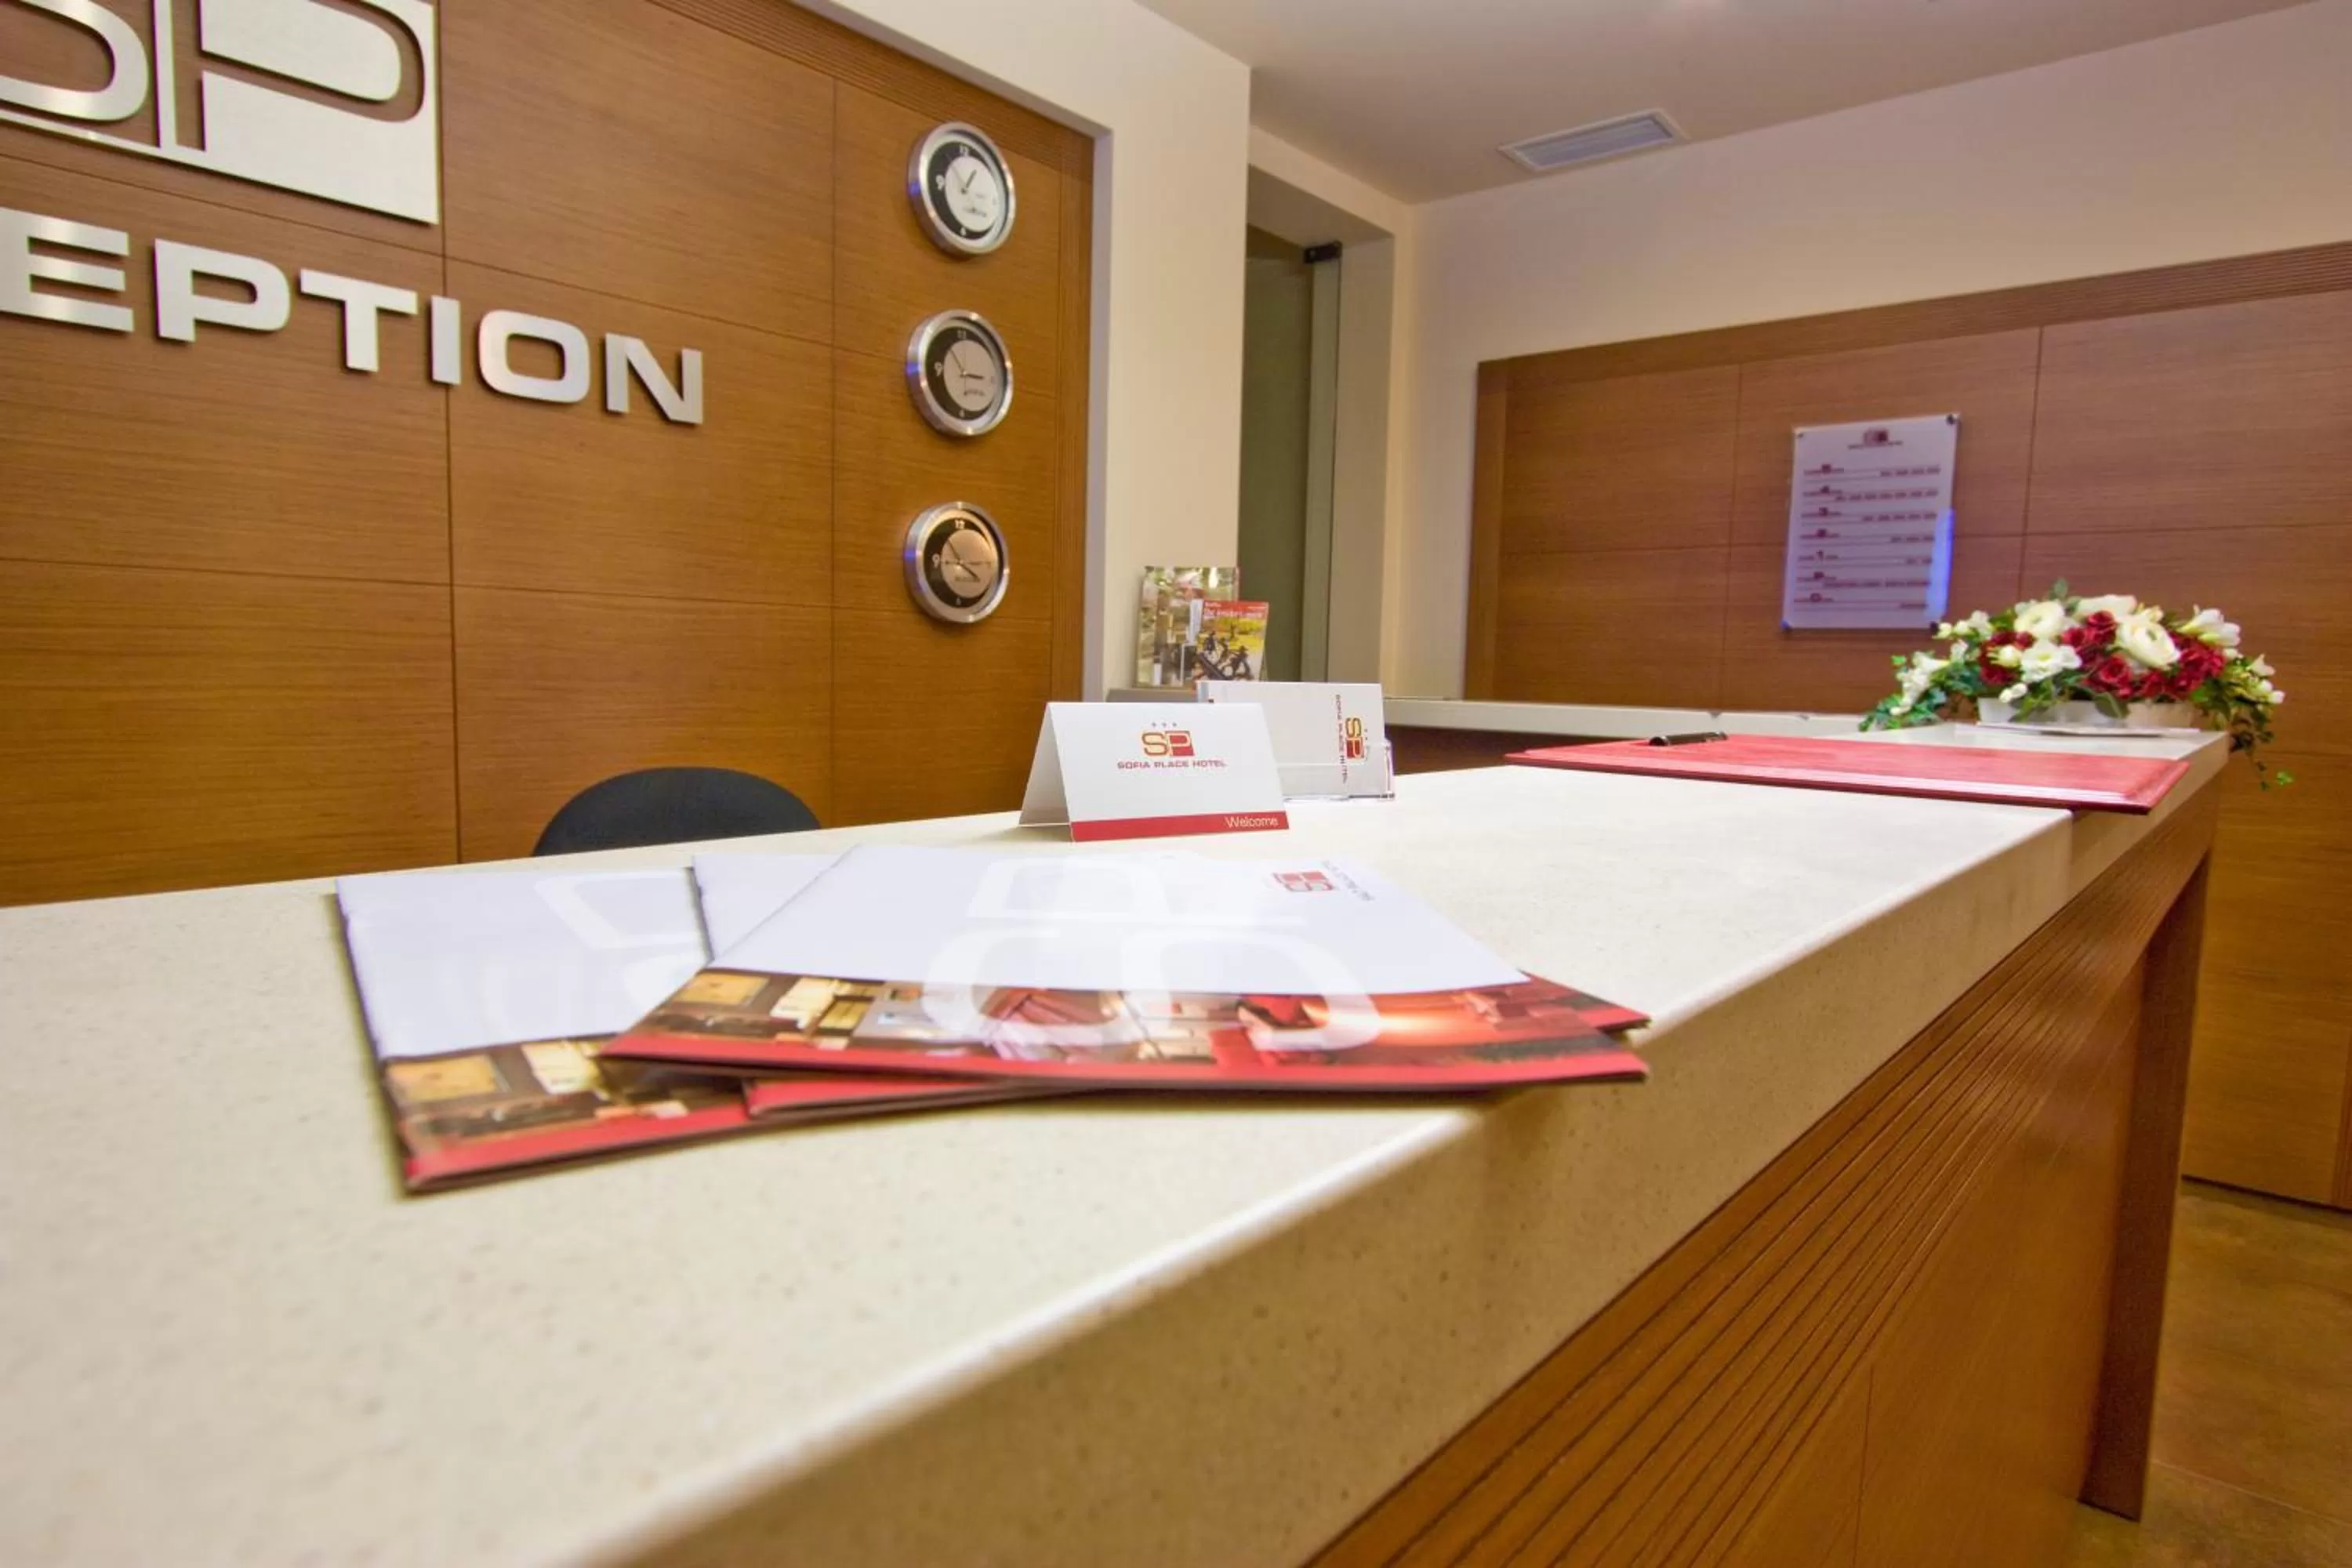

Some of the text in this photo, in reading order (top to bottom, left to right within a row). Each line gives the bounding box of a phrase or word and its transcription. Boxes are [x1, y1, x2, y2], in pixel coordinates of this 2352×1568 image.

[0, 206, 703, 426] EPTION
[1117, 760, 1151, 769] SOFIA
[1192, 759, 1227, 768] HOTEL
[1224, 815, 1279, 829] Welcome
